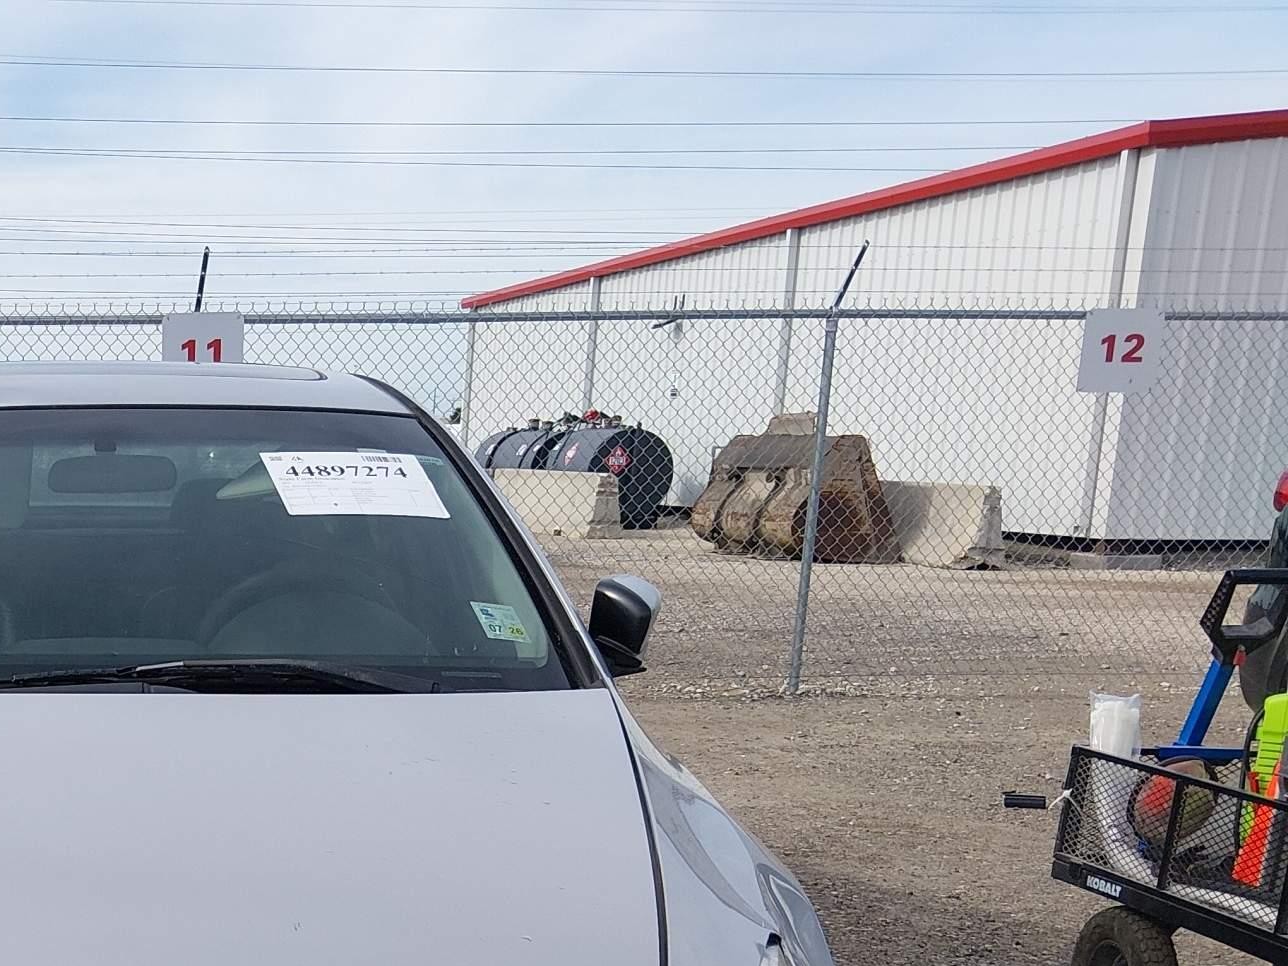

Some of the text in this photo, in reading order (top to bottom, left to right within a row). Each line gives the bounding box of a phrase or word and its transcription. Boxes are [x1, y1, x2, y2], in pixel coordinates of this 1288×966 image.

[181, 338, 222, 362] 11
[1101, 333, 1145, 363] 12
[285, 464, 408, 479] 44897274
[488, 623, 502, 633] 07
[1086, 875, 1123, 898] KOBALT
